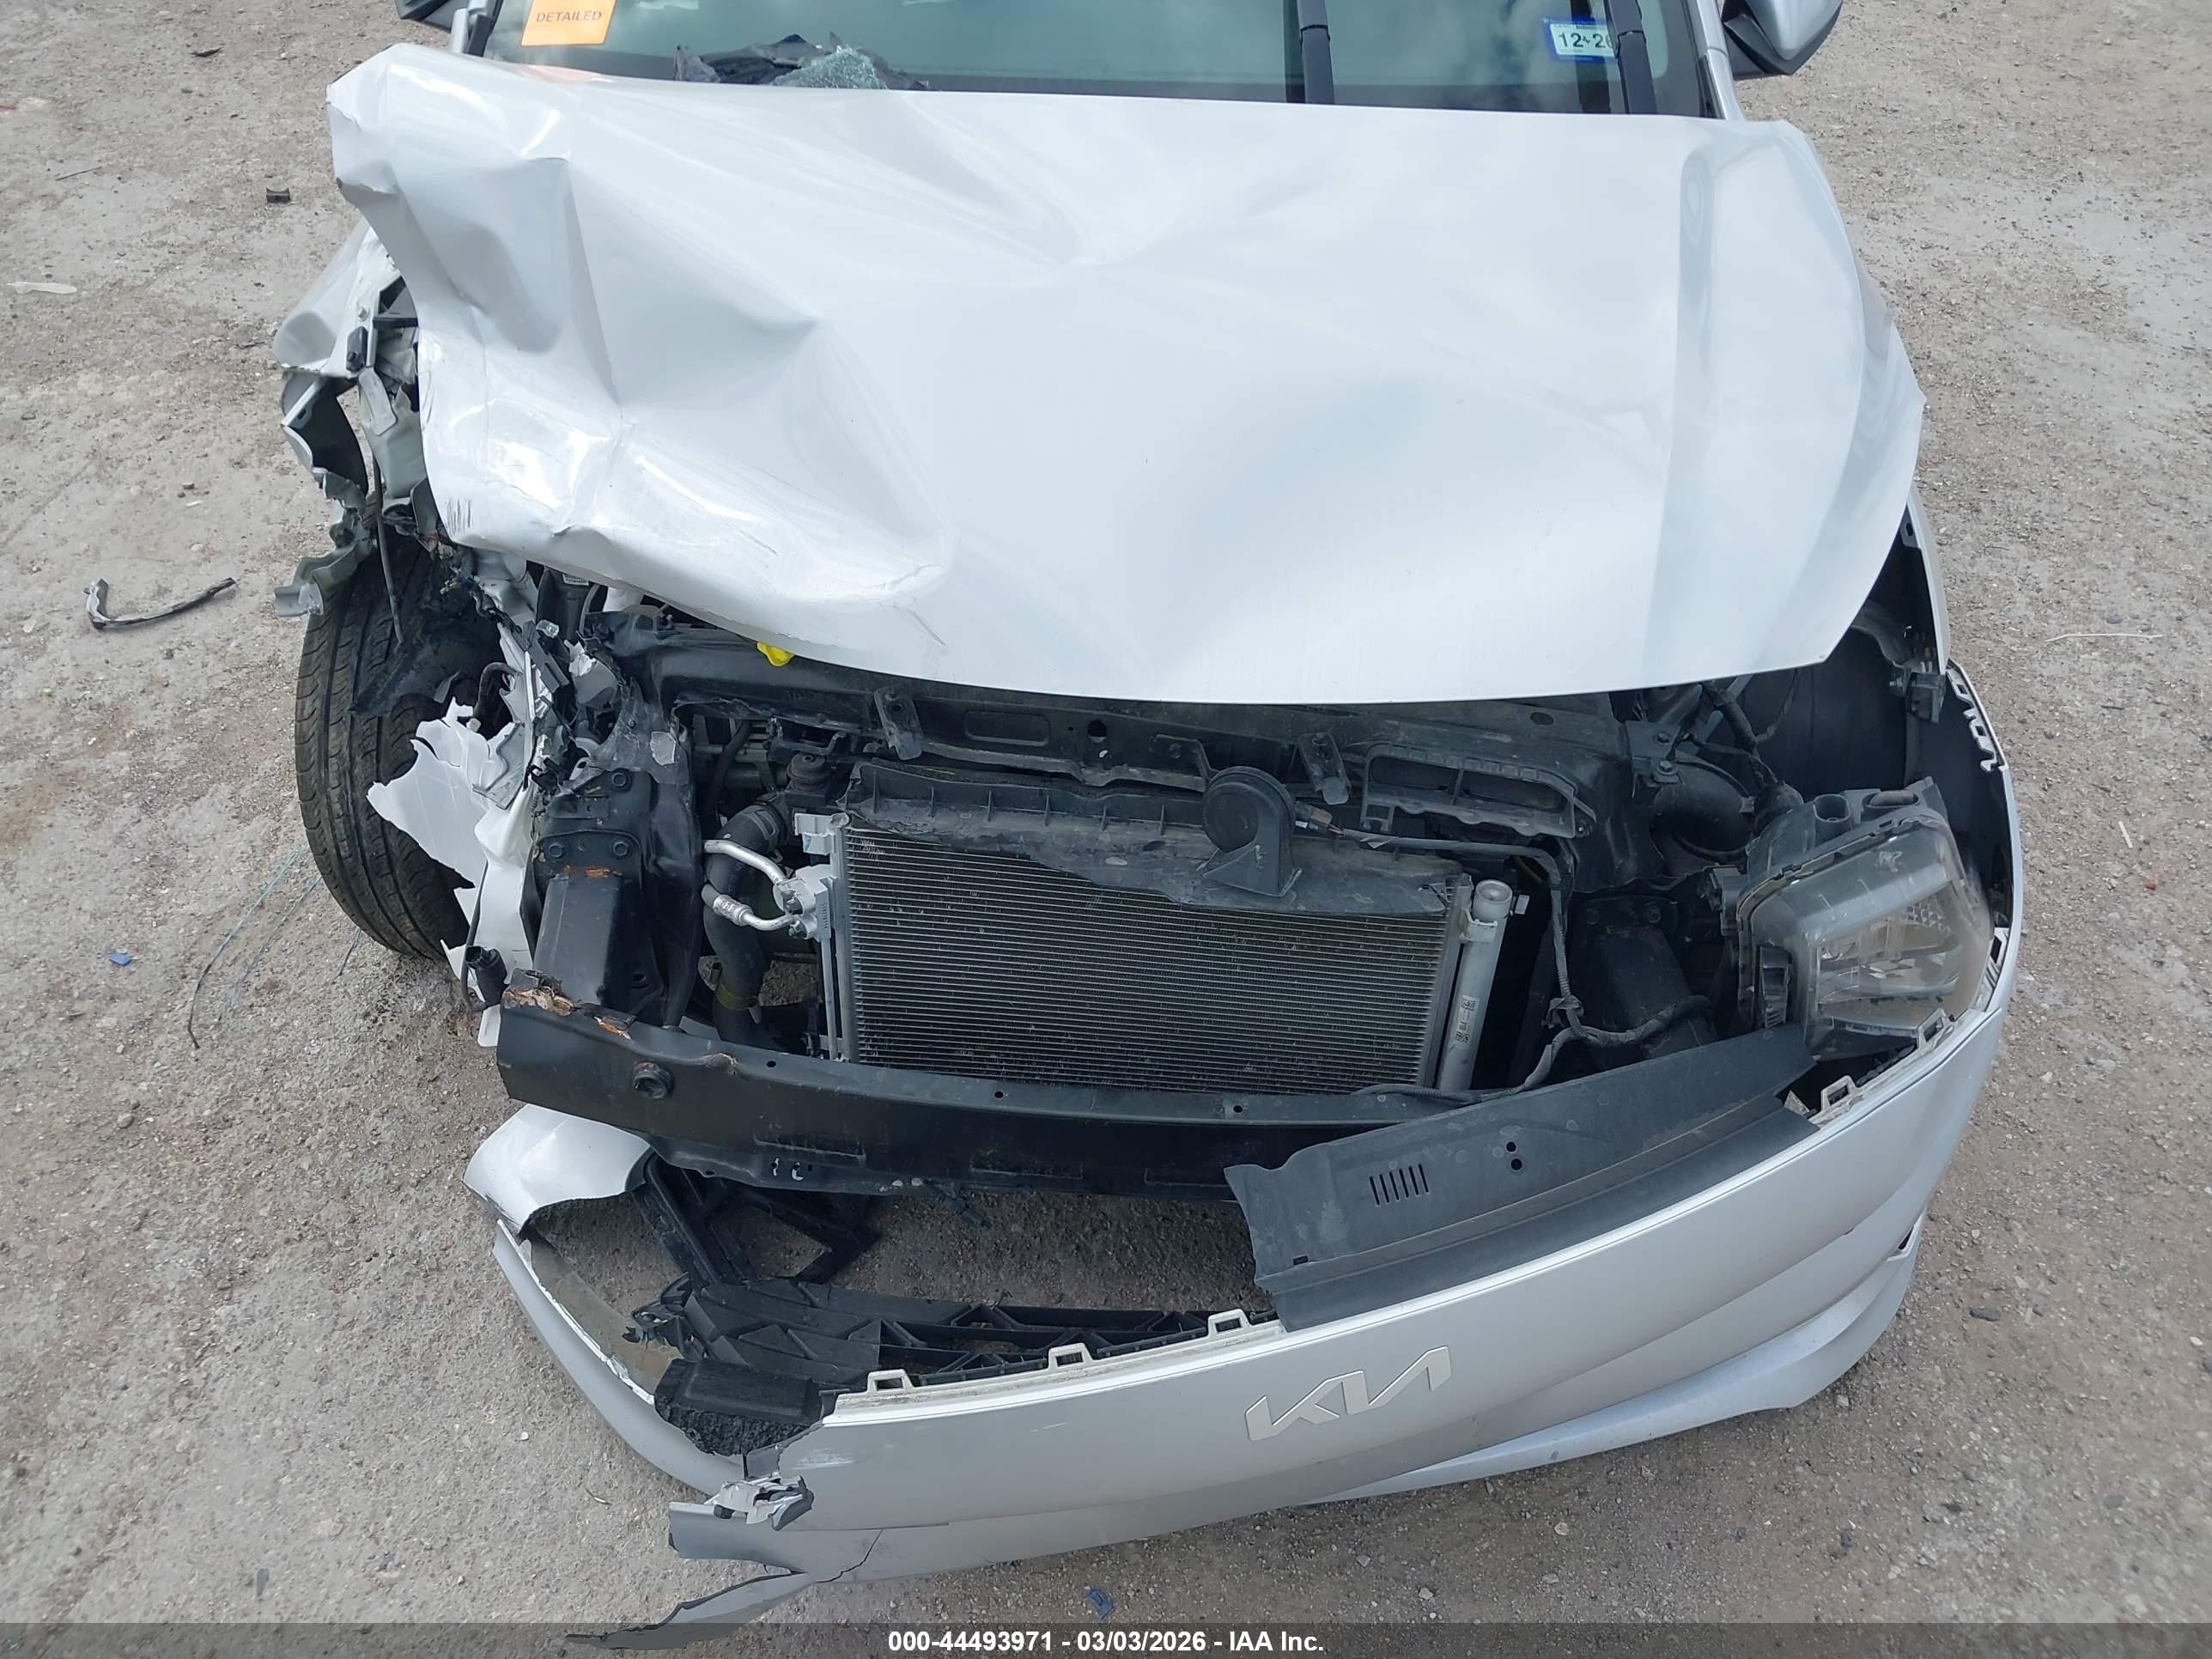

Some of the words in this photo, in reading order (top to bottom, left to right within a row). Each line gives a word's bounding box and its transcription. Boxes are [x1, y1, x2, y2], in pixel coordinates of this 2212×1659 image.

[536, 10, 602, 23] DETAILED
[1559, 32, 1583, 47] 12
[1244, 1346, 1452, 1442] KIA
